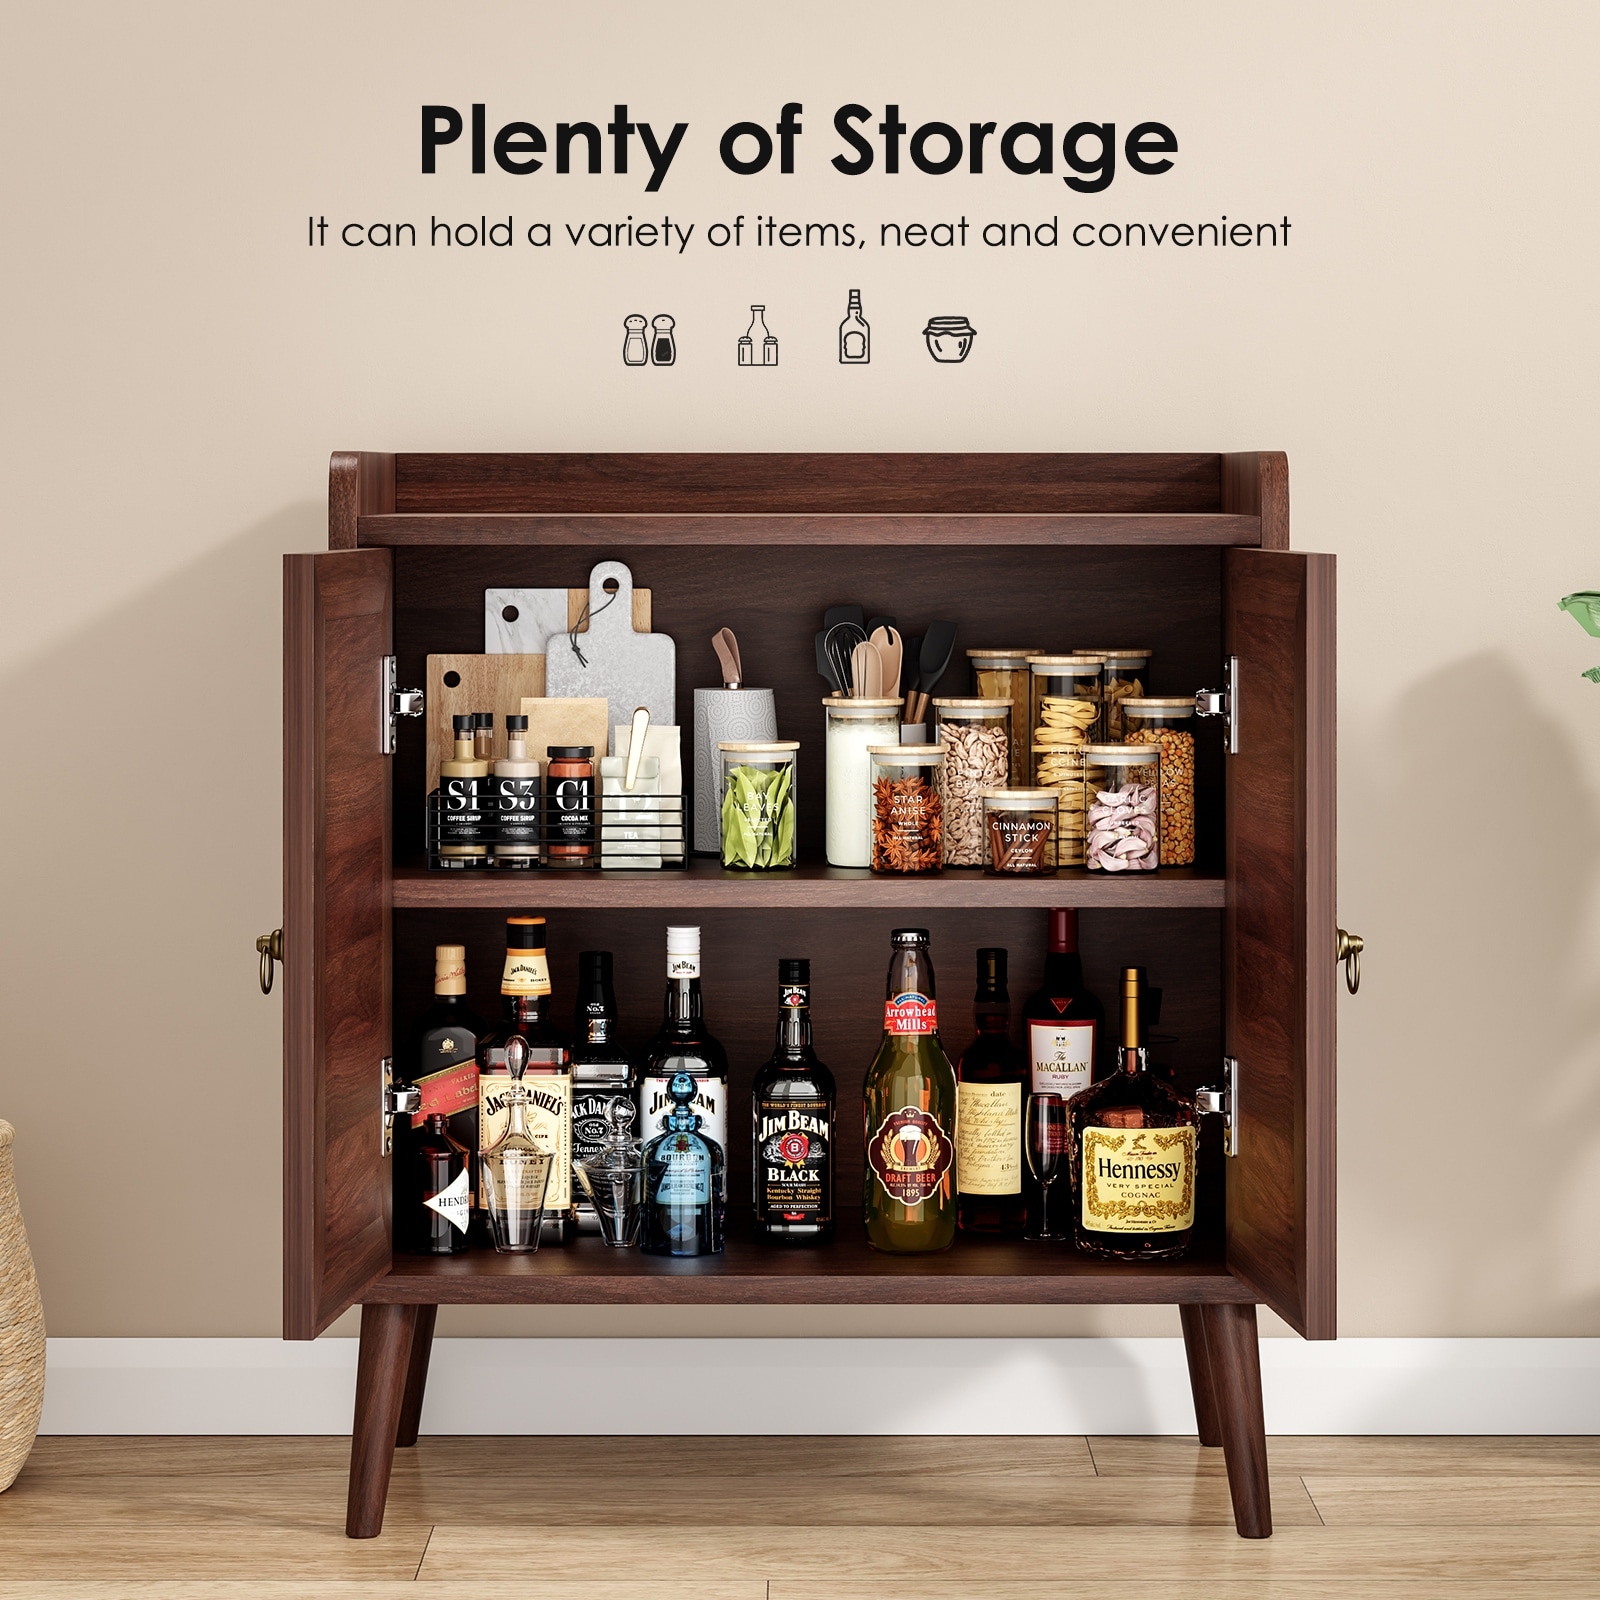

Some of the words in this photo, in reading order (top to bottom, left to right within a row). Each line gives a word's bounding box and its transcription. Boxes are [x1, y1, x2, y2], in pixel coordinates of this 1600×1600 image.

[1137, 767, 1184, 777] YELOW
[446, 779, 481, 811] S1
[498, 779, 536, 811] S3
[555, 779, 591, 811] C1
[747, 791, 768, 801] BAY
[893, 795, 923, 804] STAR
[1103, 795, 1147, 804] GARLIC
[737, 802, 779, 812] LEAVES
[890, 806, 926, 815] ANISE
[1102, 806, 1147, 815] CLOVES
[991, 821, 1051, 831] CINNAMON
[624, 831, 640, 840] TEA
[1005, 833, 1039, 842] STICK
[896, 1018, 927, 1031] Mills
[1053, 1050, 1067, 1062] The
[1036, 1061, 1086, 1072] MACALLAN
[758, 1115, 787, 1143] JIM
[788, 1109, 829, 1142] BEAM
[791, 1142, 800, 1154] B
[767, 1167, 821, 1182] BLACK
[1098, 1157, 1182, 1182] Hennessy
[885, 1173, 911, 1183] DRAFT
[915, 1173, 936, 1183] BEER
[766, 1187, 794, 1195] Kentucky
[797, 1187, 822, 1195] Straight
[1106, 1182, 1131, 1190] VERY
[1134, 1182, 1175, 1190] SPECIAL
[902, 1188, 920, 1197] 1895
[796, 1194, 821, 1202] Whiskey
